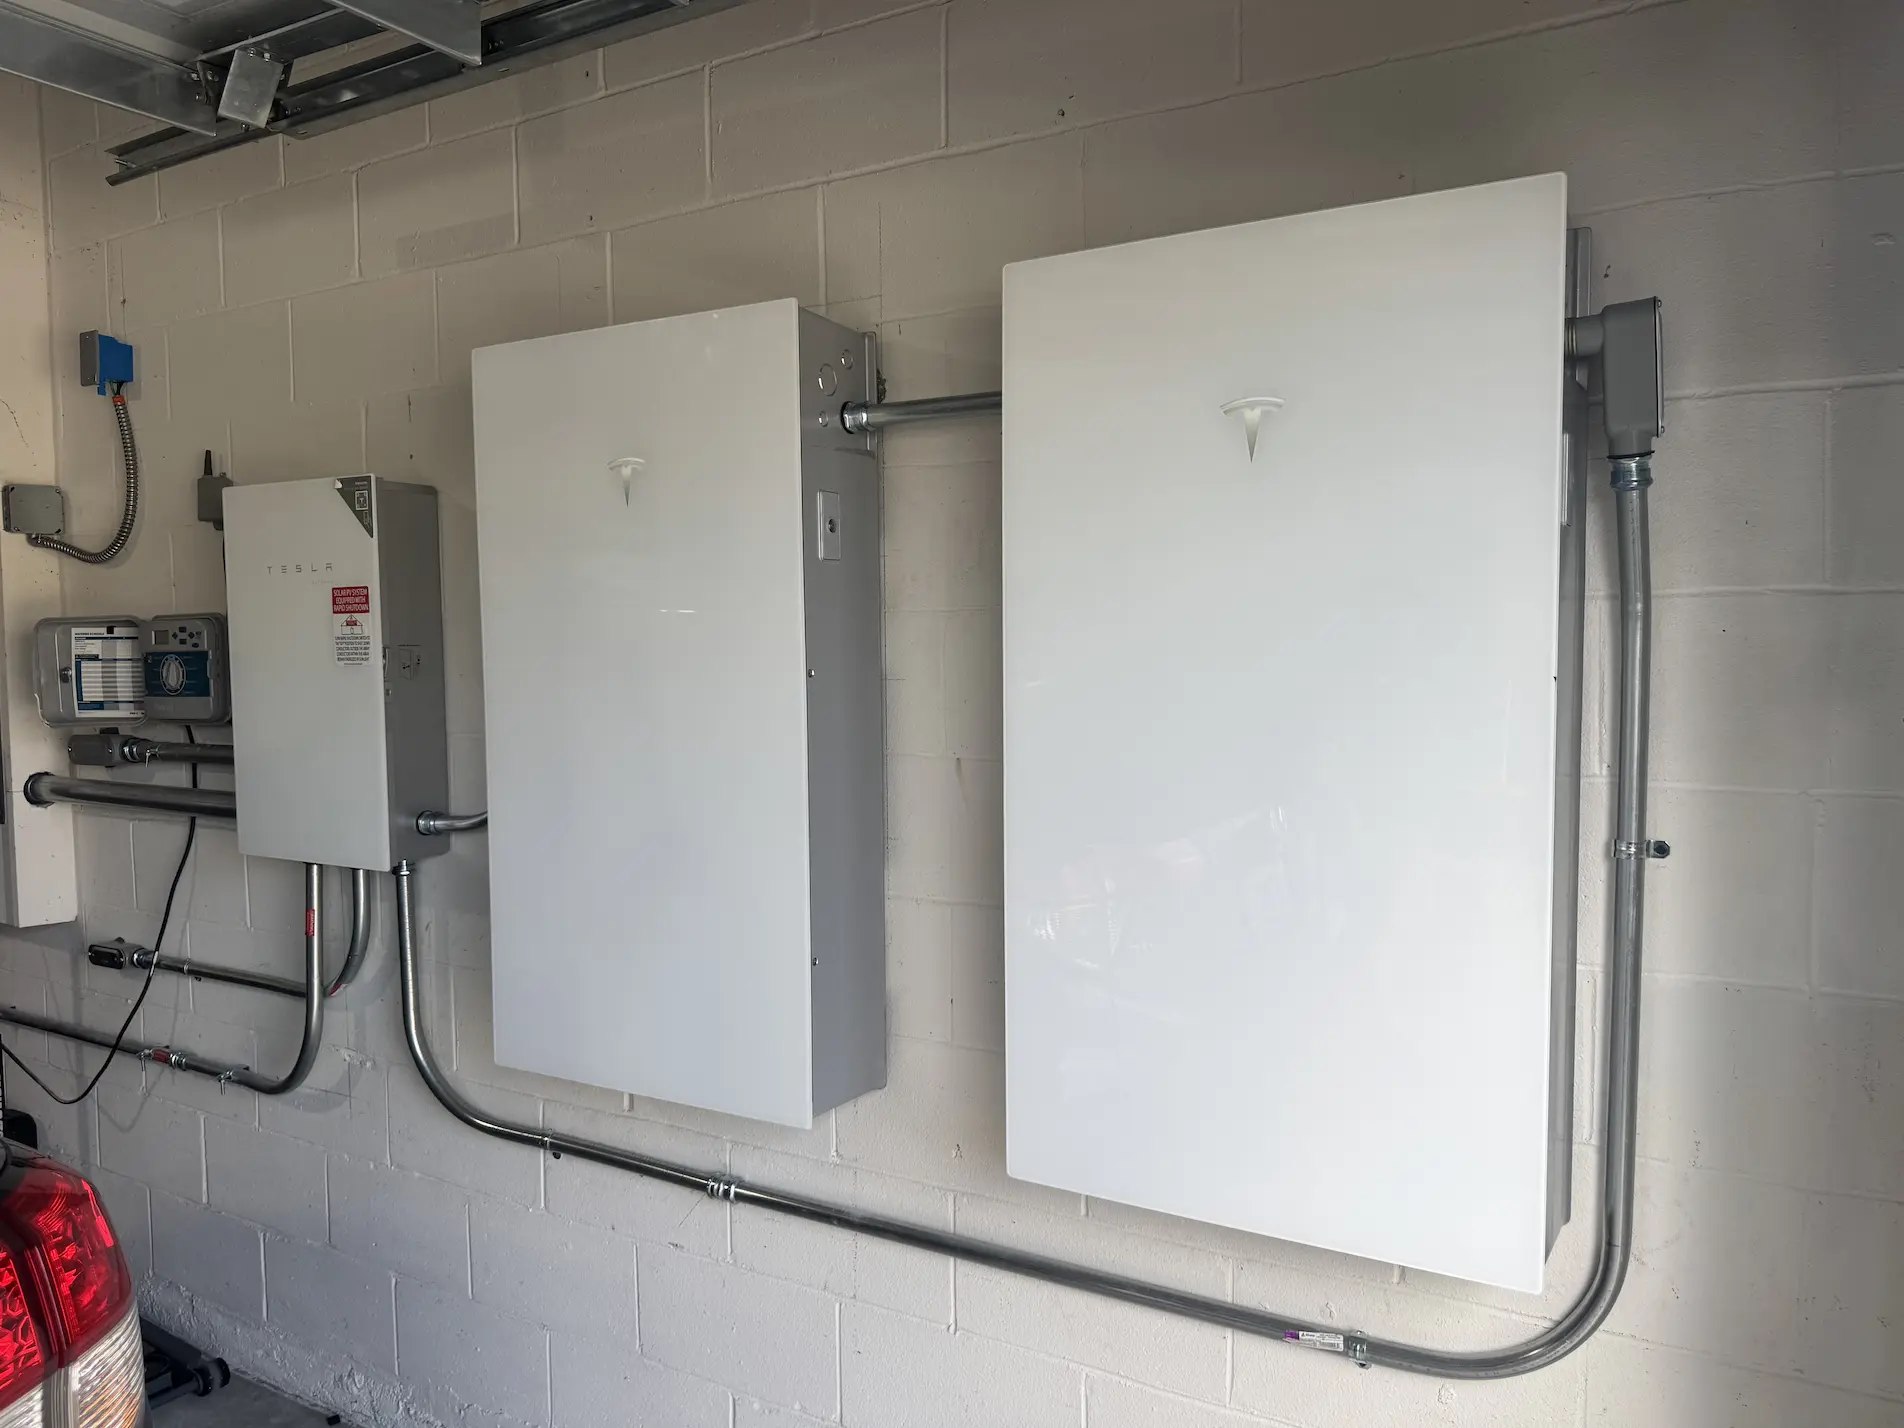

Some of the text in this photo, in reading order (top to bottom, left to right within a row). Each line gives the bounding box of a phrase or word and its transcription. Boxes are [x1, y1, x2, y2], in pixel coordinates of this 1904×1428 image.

[267, 562, 333, 575] TESLA
[333, 588, 368, 597] SOLAR PV SYSTEM
[336, 596, 355, 604] EQUIPPED
[334, 603, 368, 612] RAPID SHUTDOWN
